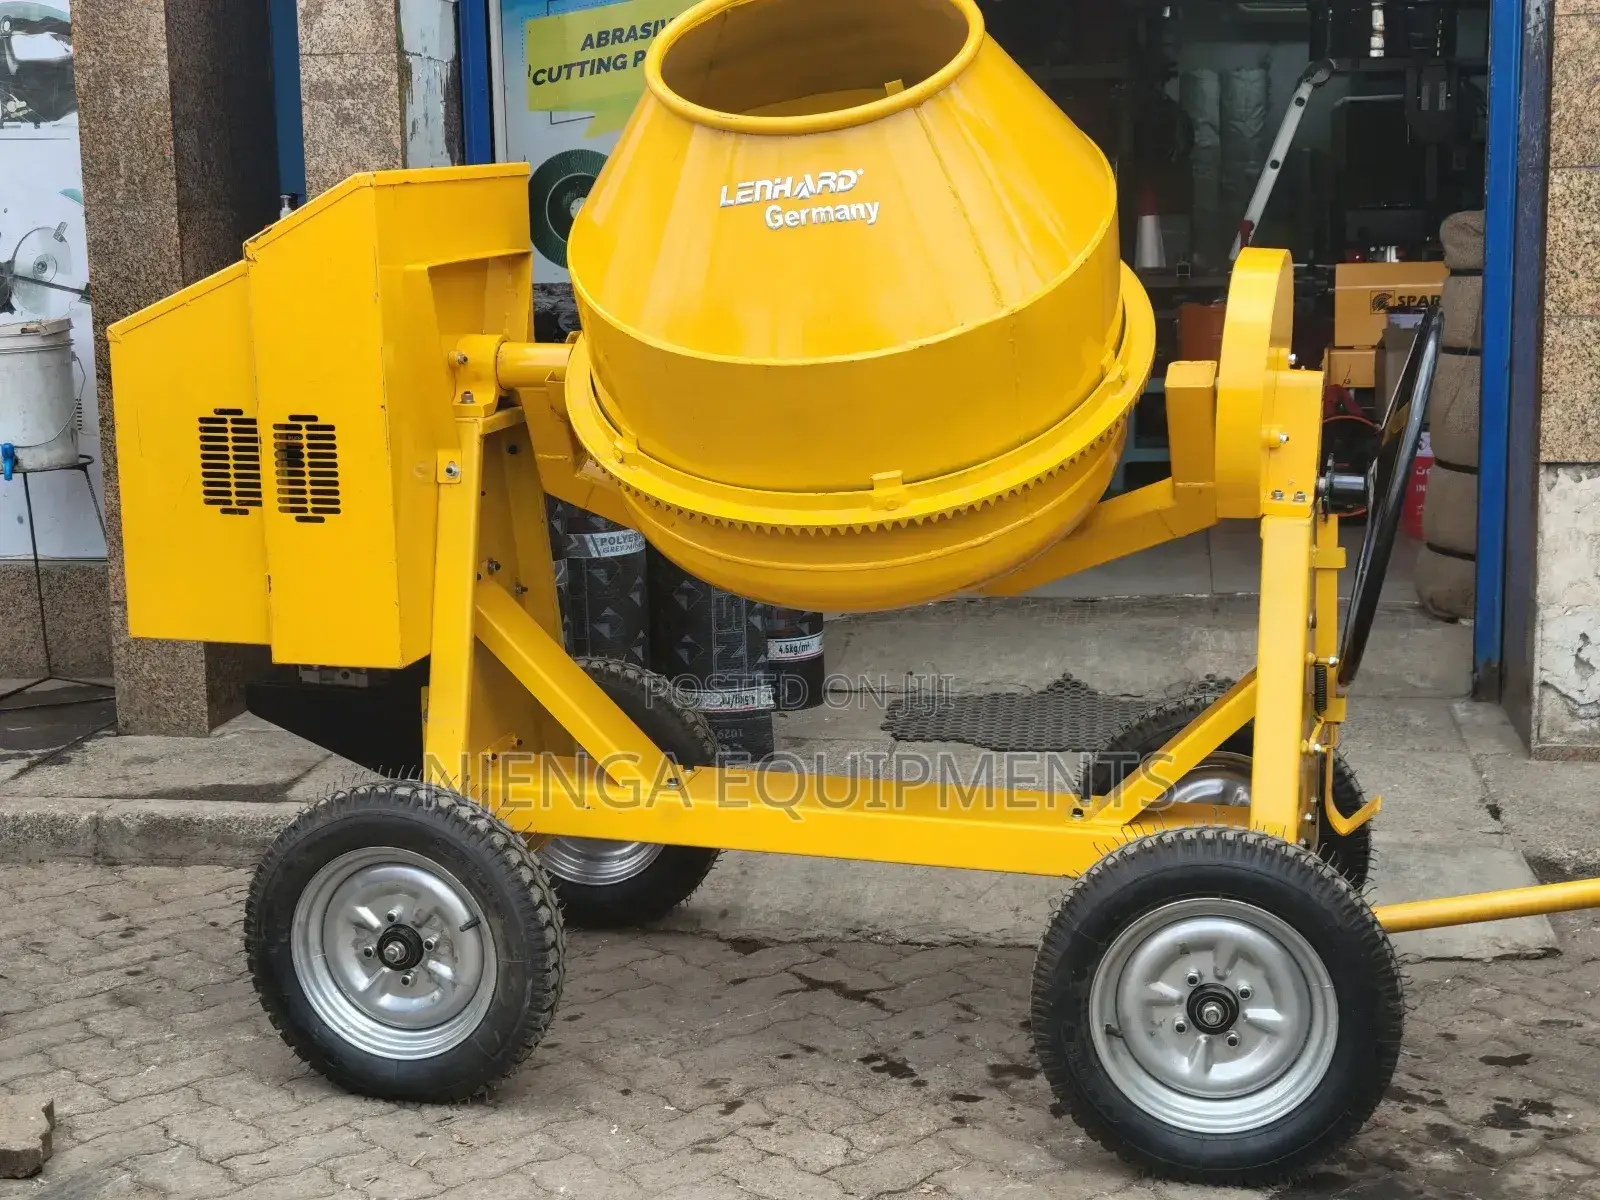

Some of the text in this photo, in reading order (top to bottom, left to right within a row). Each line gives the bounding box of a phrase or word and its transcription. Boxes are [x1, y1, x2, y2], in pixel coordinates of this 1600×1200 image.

[580, 17, 675, 52] ABRASIV
[532, 53, 628, 86] CUTTING
[765, 201, 880, 230] Germany
[1397, 294, 1441, 307] SPAR
[600, 532, 644, 546] POLYES
